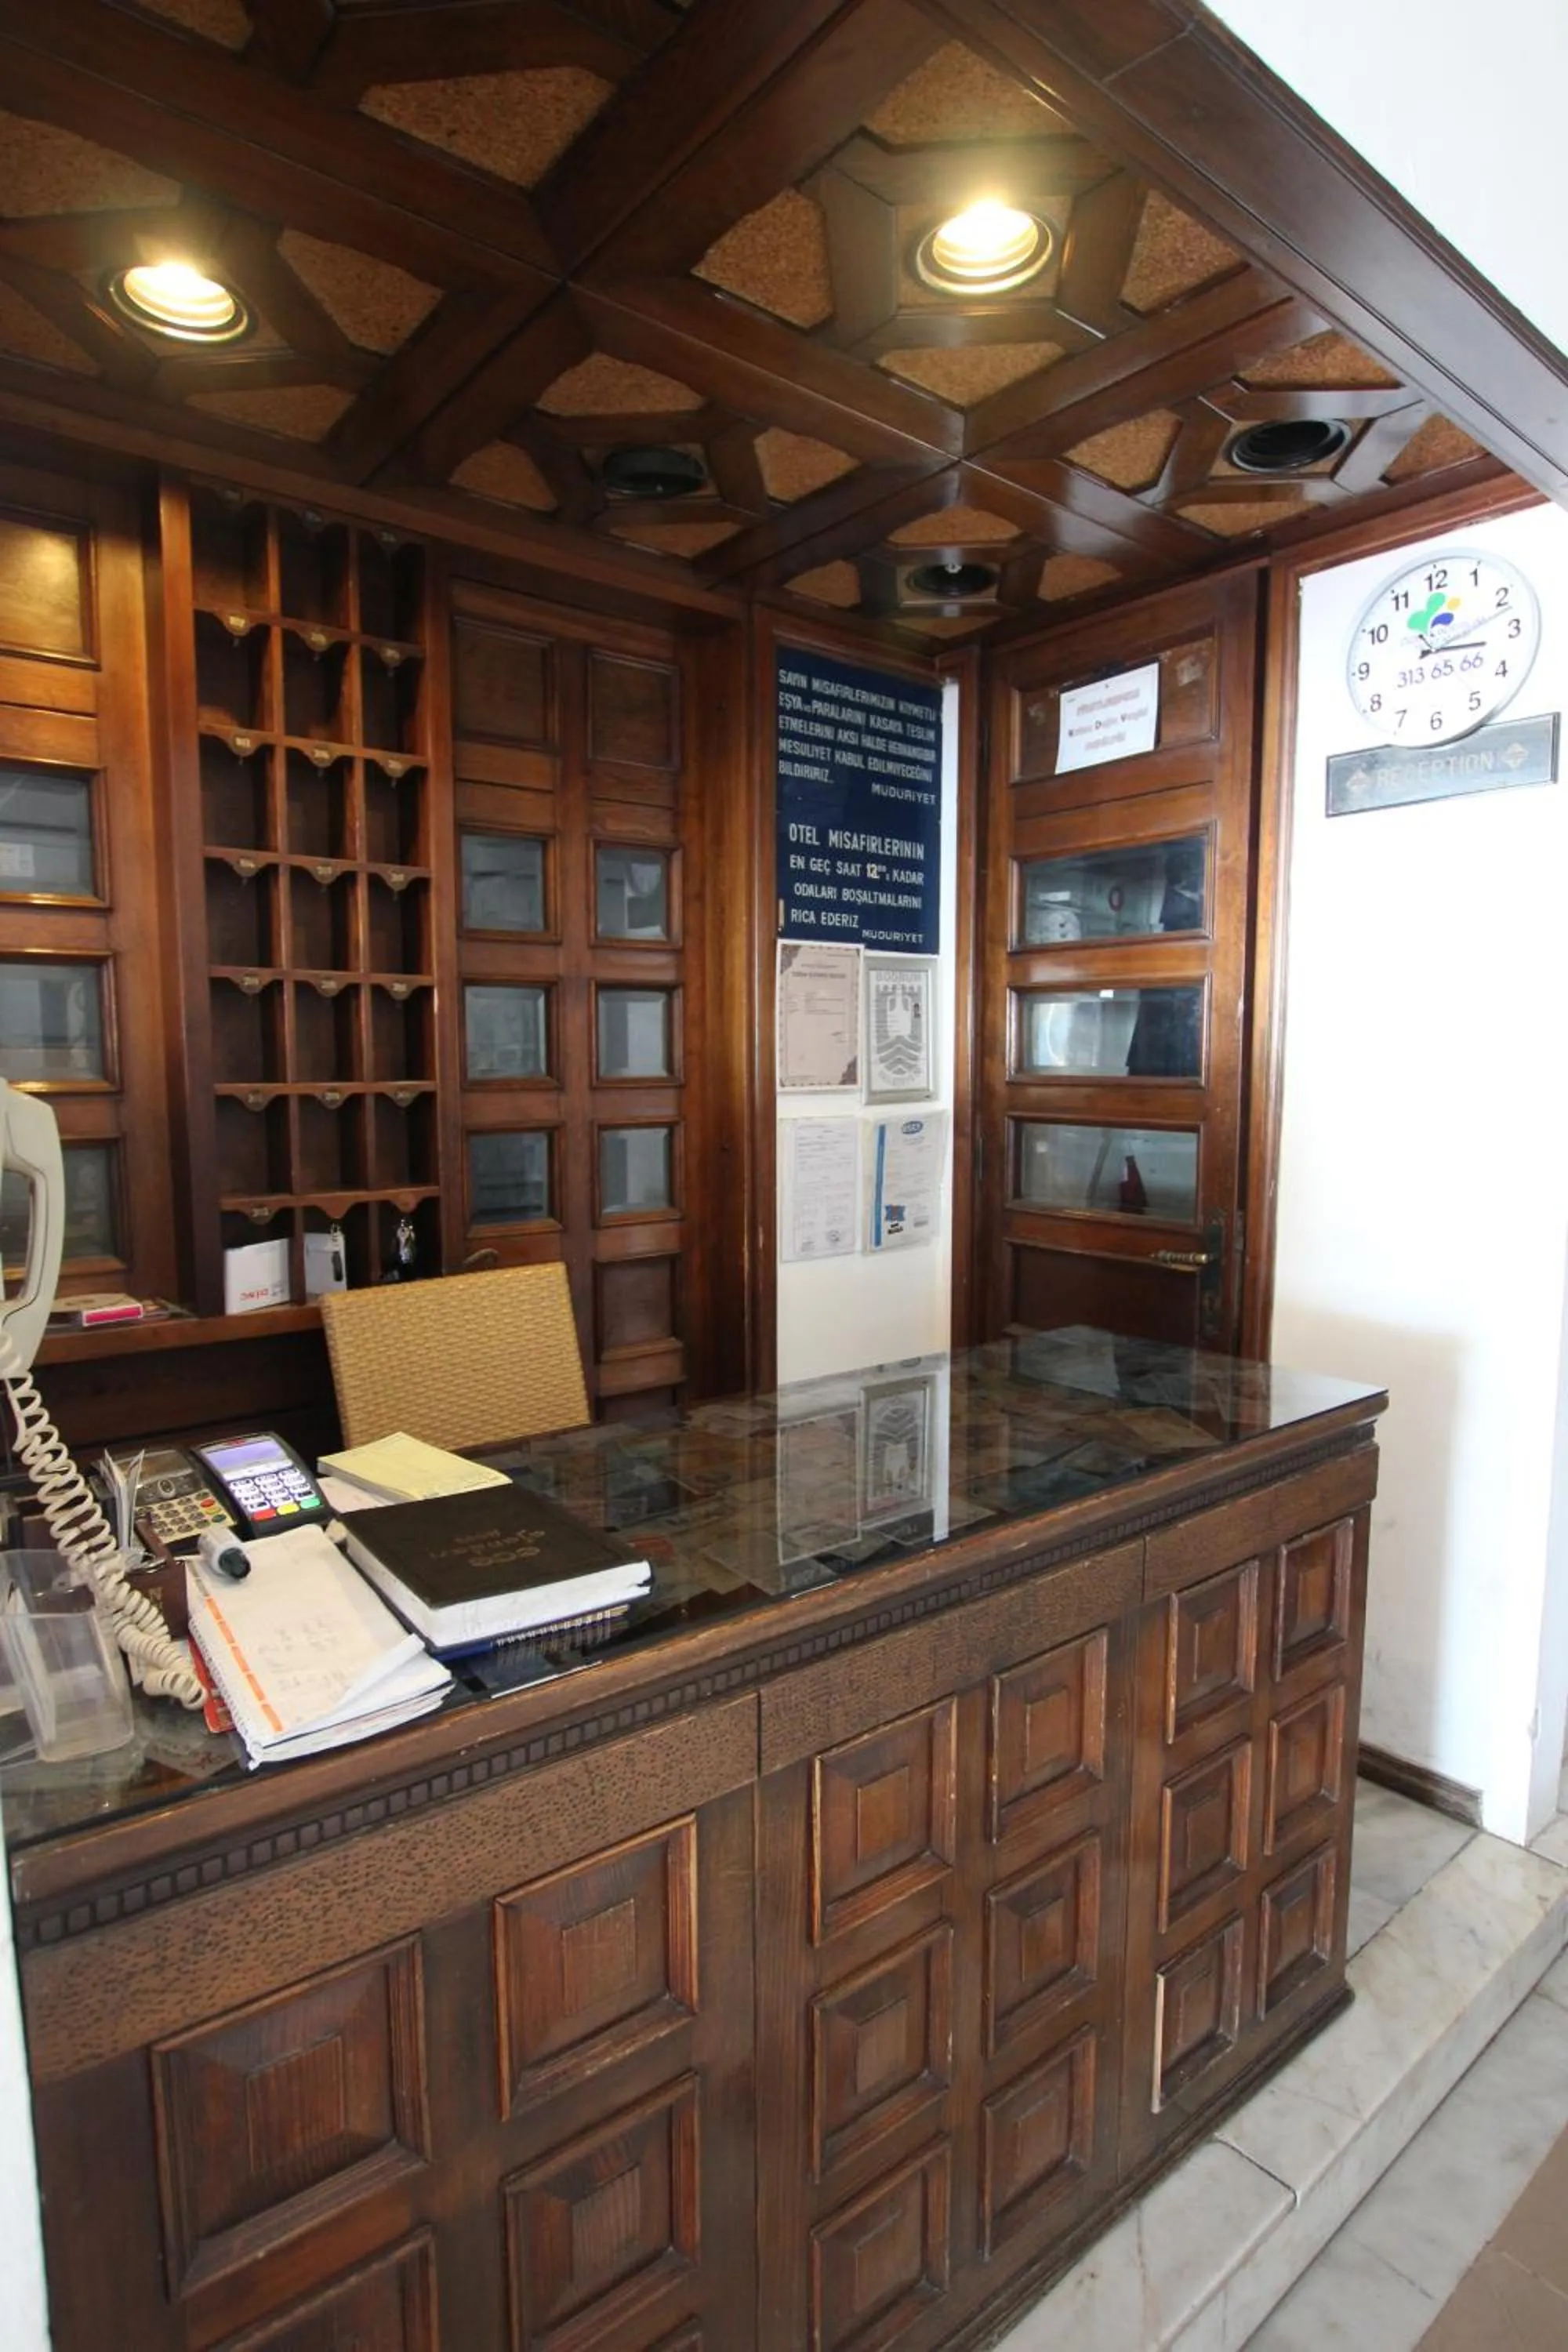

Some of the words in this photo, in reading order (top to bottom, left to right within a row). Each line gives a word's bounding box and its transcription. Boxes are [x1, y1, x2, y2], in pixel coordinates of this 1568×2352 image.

[1425, 568, 1448, 591] 12
[1469, 568, 1479, 587] 1
[1391, 590, 1410, 612] 11
[1495, 587, 1509, 608] 2
[1367, 624, 1388, 644] 10
[1508, 619, 1522, 640] 3
[1357, 662, 1370, 681] 9
[1397, 667, 1425, 688] 313
[1431, 659, 1454, 679] 65
[1460, 652, 1483, 672] 66
[1494, 660, 1508, 678] 4
[1370, 694, 1382, 713] 8
[1468, 691, 1482, 711] 5
[1395, 710, 1407, 728] 7
[1430, 712, 1443, 731] 6
[1376, 750, 1494, 787] RECEPTION
[789, 823, 820, 845] OTEL
[790, 855, 805, 869] EN
[810, 858, 831, 875] GEÇ
[836, 860, 862, 877] SAAT
[892, 869, 924, 887] KADAR
[794, 883, 837, 900] ODALARI
[842, 888, 923, 909] BOŞALTMALARINI
